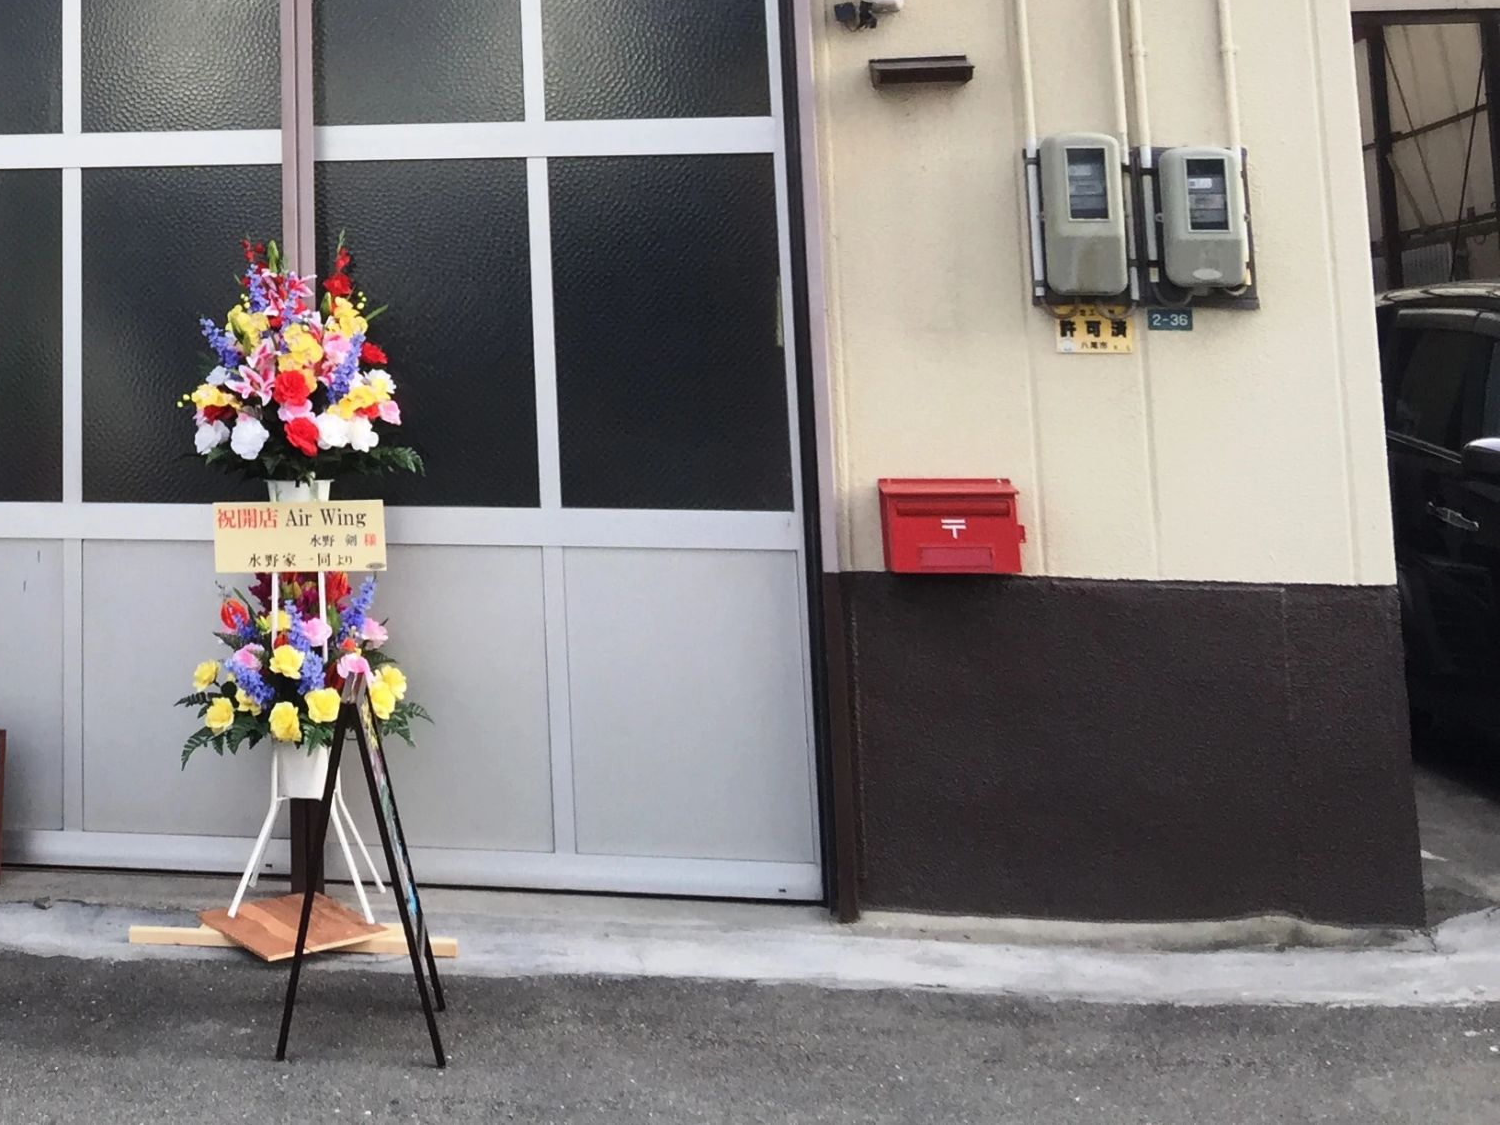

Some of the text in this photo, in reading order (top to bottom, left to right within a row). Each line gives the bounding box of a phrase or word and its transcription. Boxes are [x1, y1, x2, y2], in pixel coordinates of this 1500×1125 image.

[1152, 313, 1189, 326] 2-36
[217, 508, 368, 529] 祝開店 Air Wing
